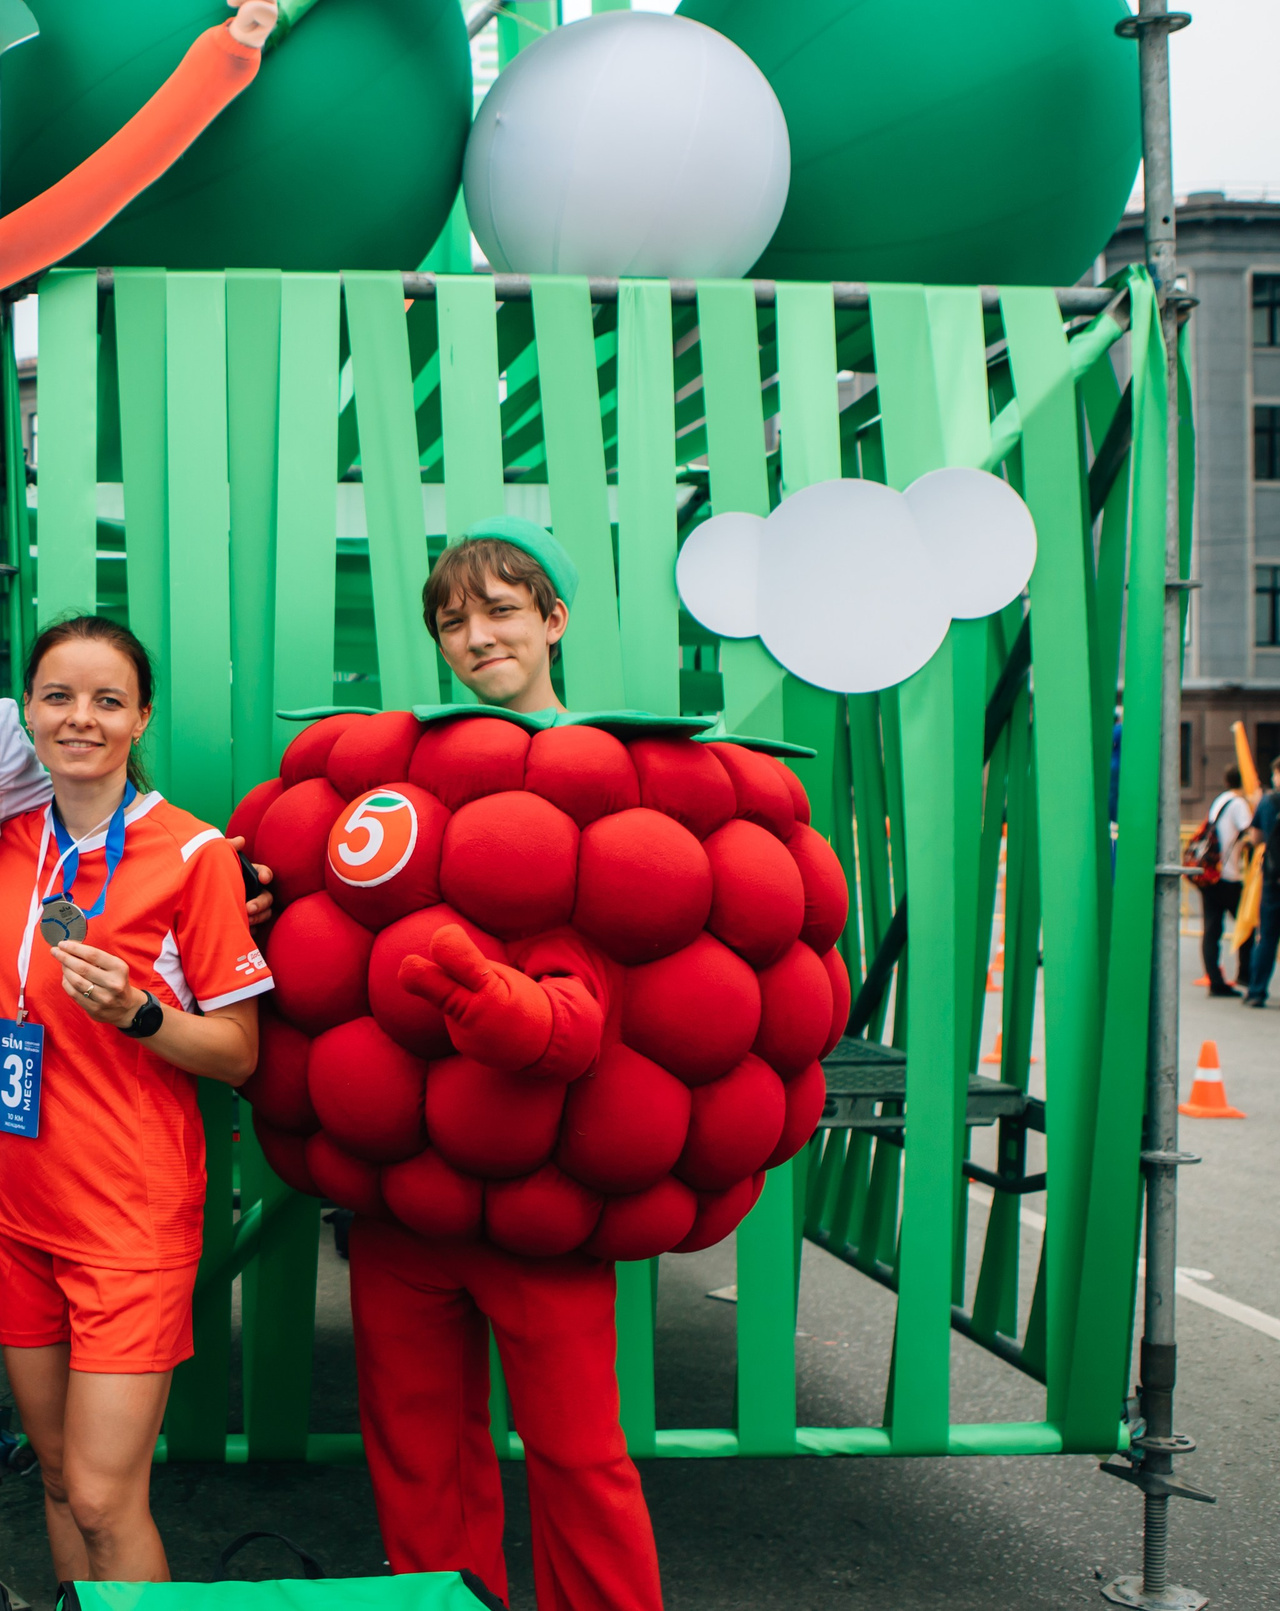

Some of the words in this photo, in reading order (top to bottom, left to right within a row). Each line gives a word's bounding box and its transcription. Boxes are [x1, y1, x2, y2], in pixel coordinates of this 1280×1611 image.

[337, 792, 407, 866] 5
[1, 1054, 24, 1108] 3
[23, 1058, 34, 1112] МЕСТО
[7, 1112, 14, 1121] 10
